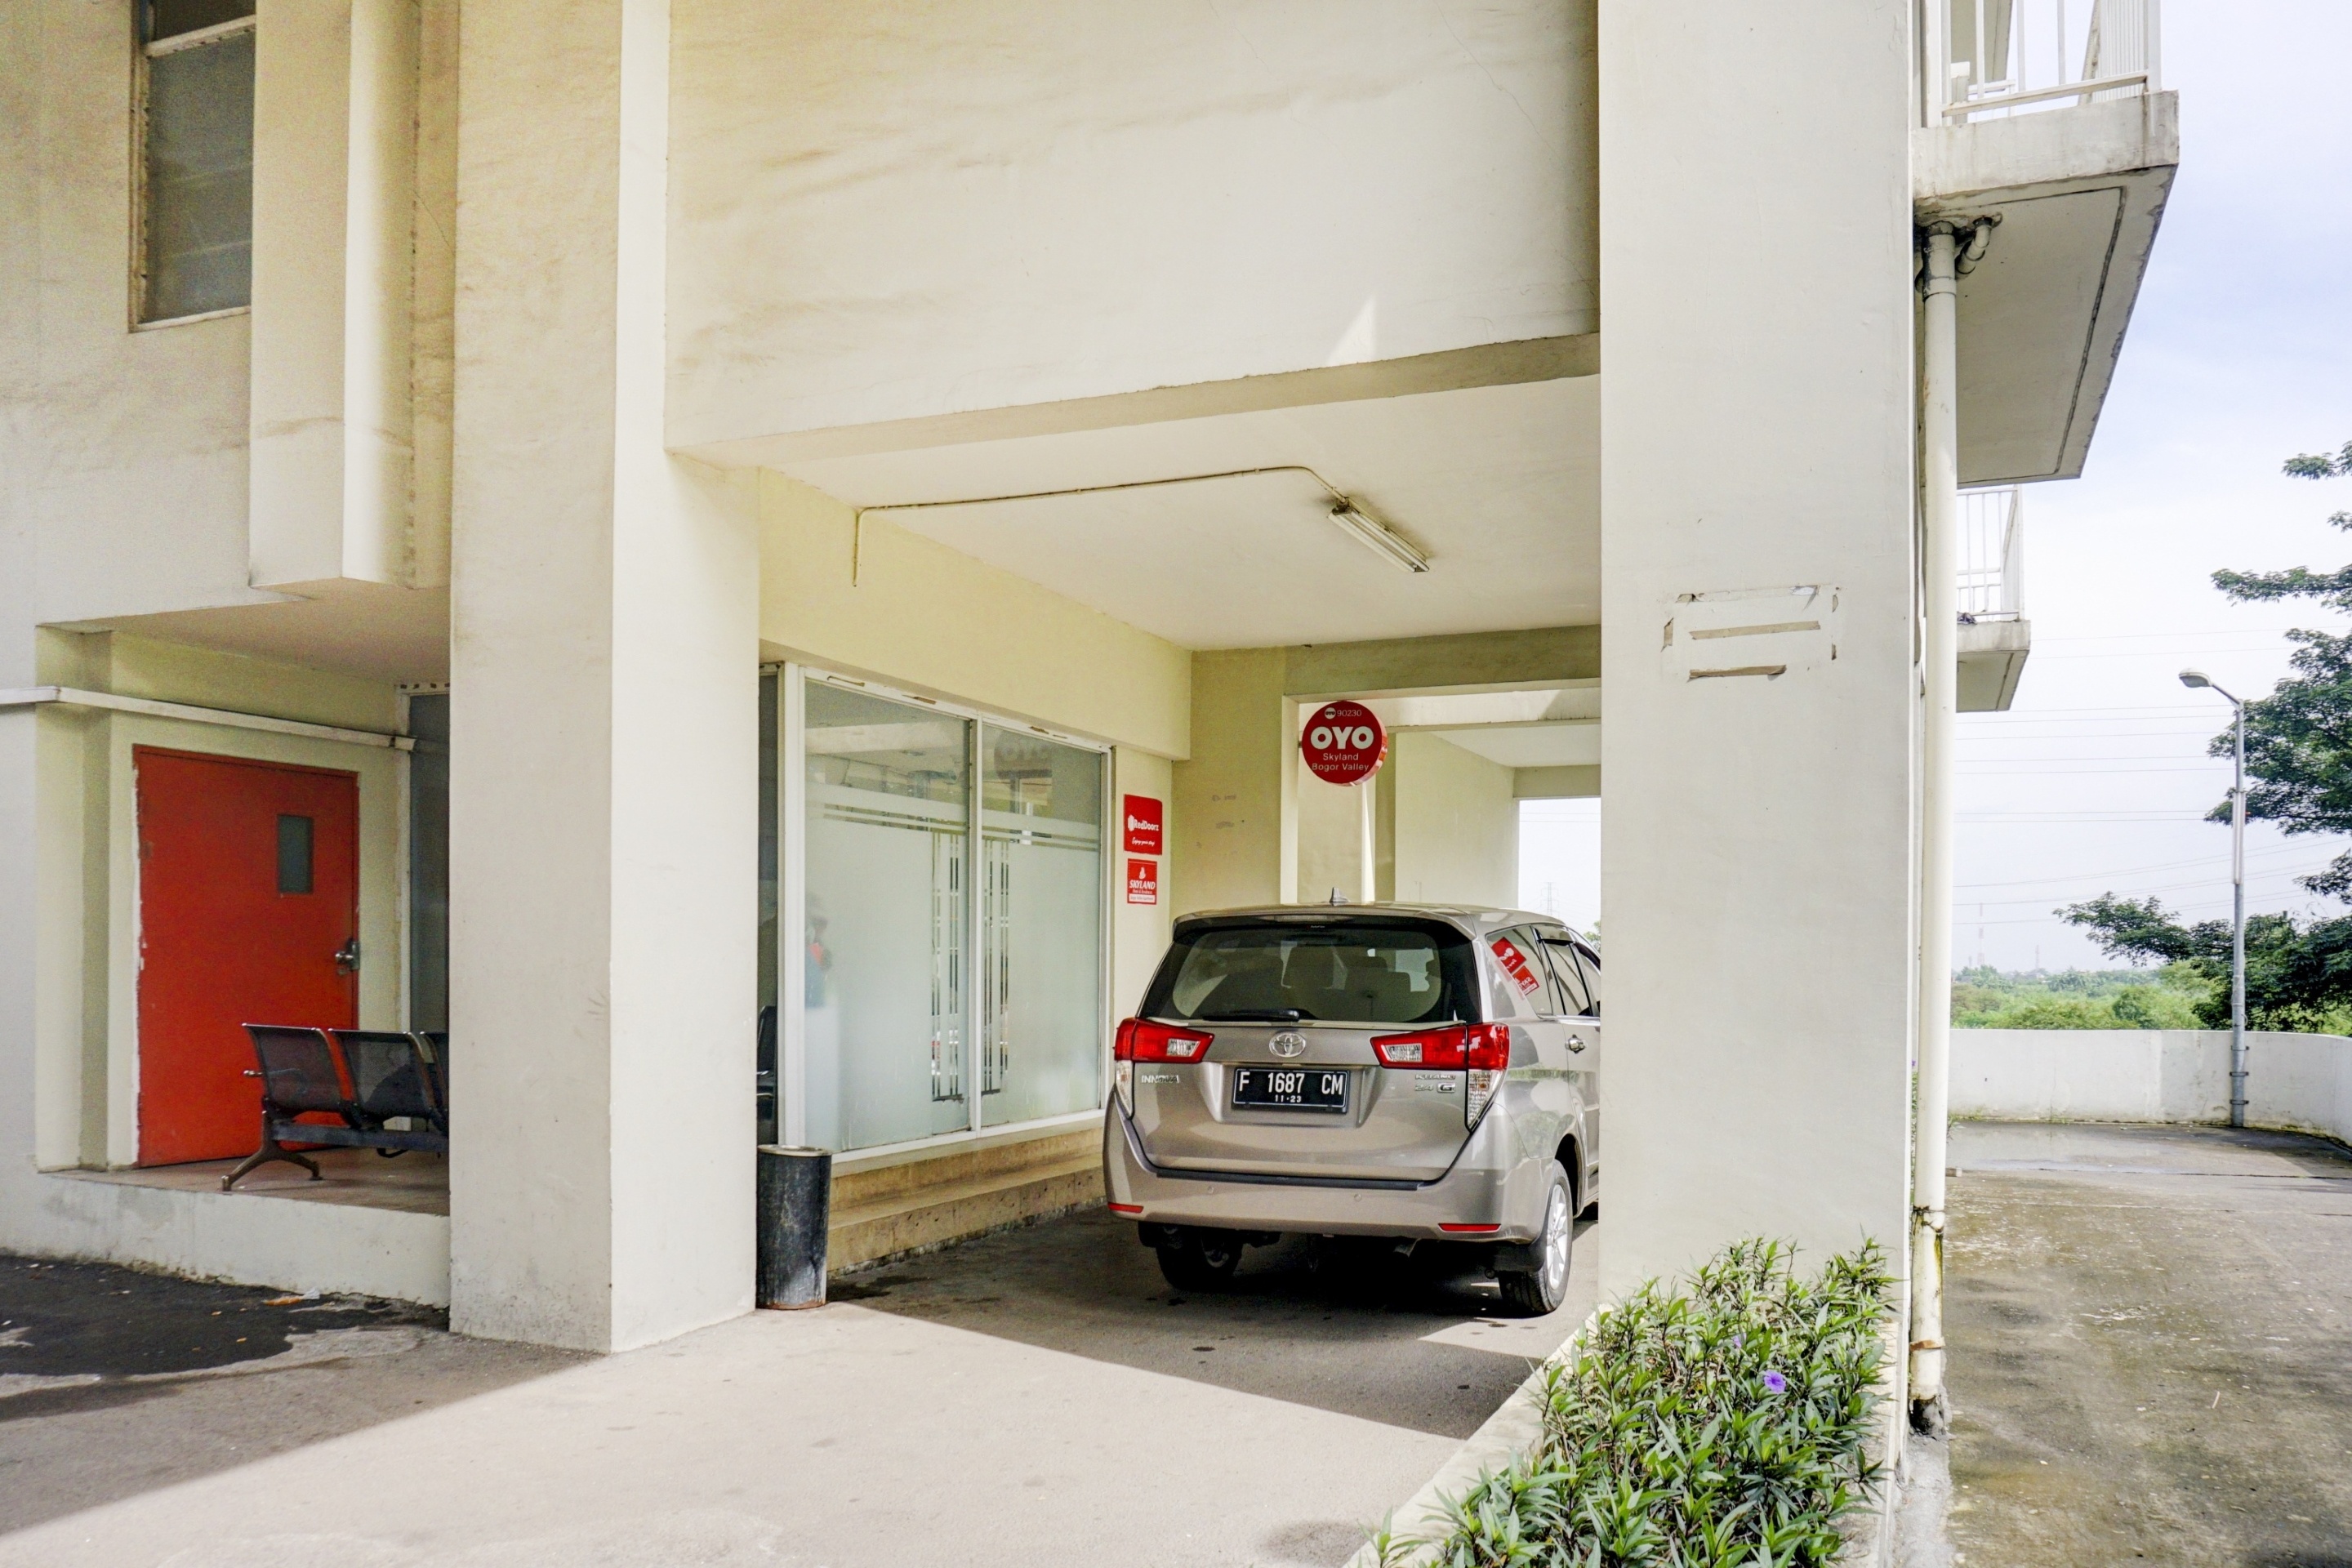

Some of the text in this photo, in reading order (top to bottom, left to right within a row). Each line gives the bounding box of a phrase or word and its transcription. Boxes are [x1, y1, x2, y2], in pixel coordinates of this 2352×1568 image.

[1310, 725, 1374, 750] OYO
[1323, 753, 1359, 761] Skyland
[1312, 763, 1370, 772] Bogor Valley
[1134, 819, 1159, 831] RedDoorz
[1129, 880, 1156, 889] SKYLAND
[1239, 1071, 1343, 1095] F 1687 CM
